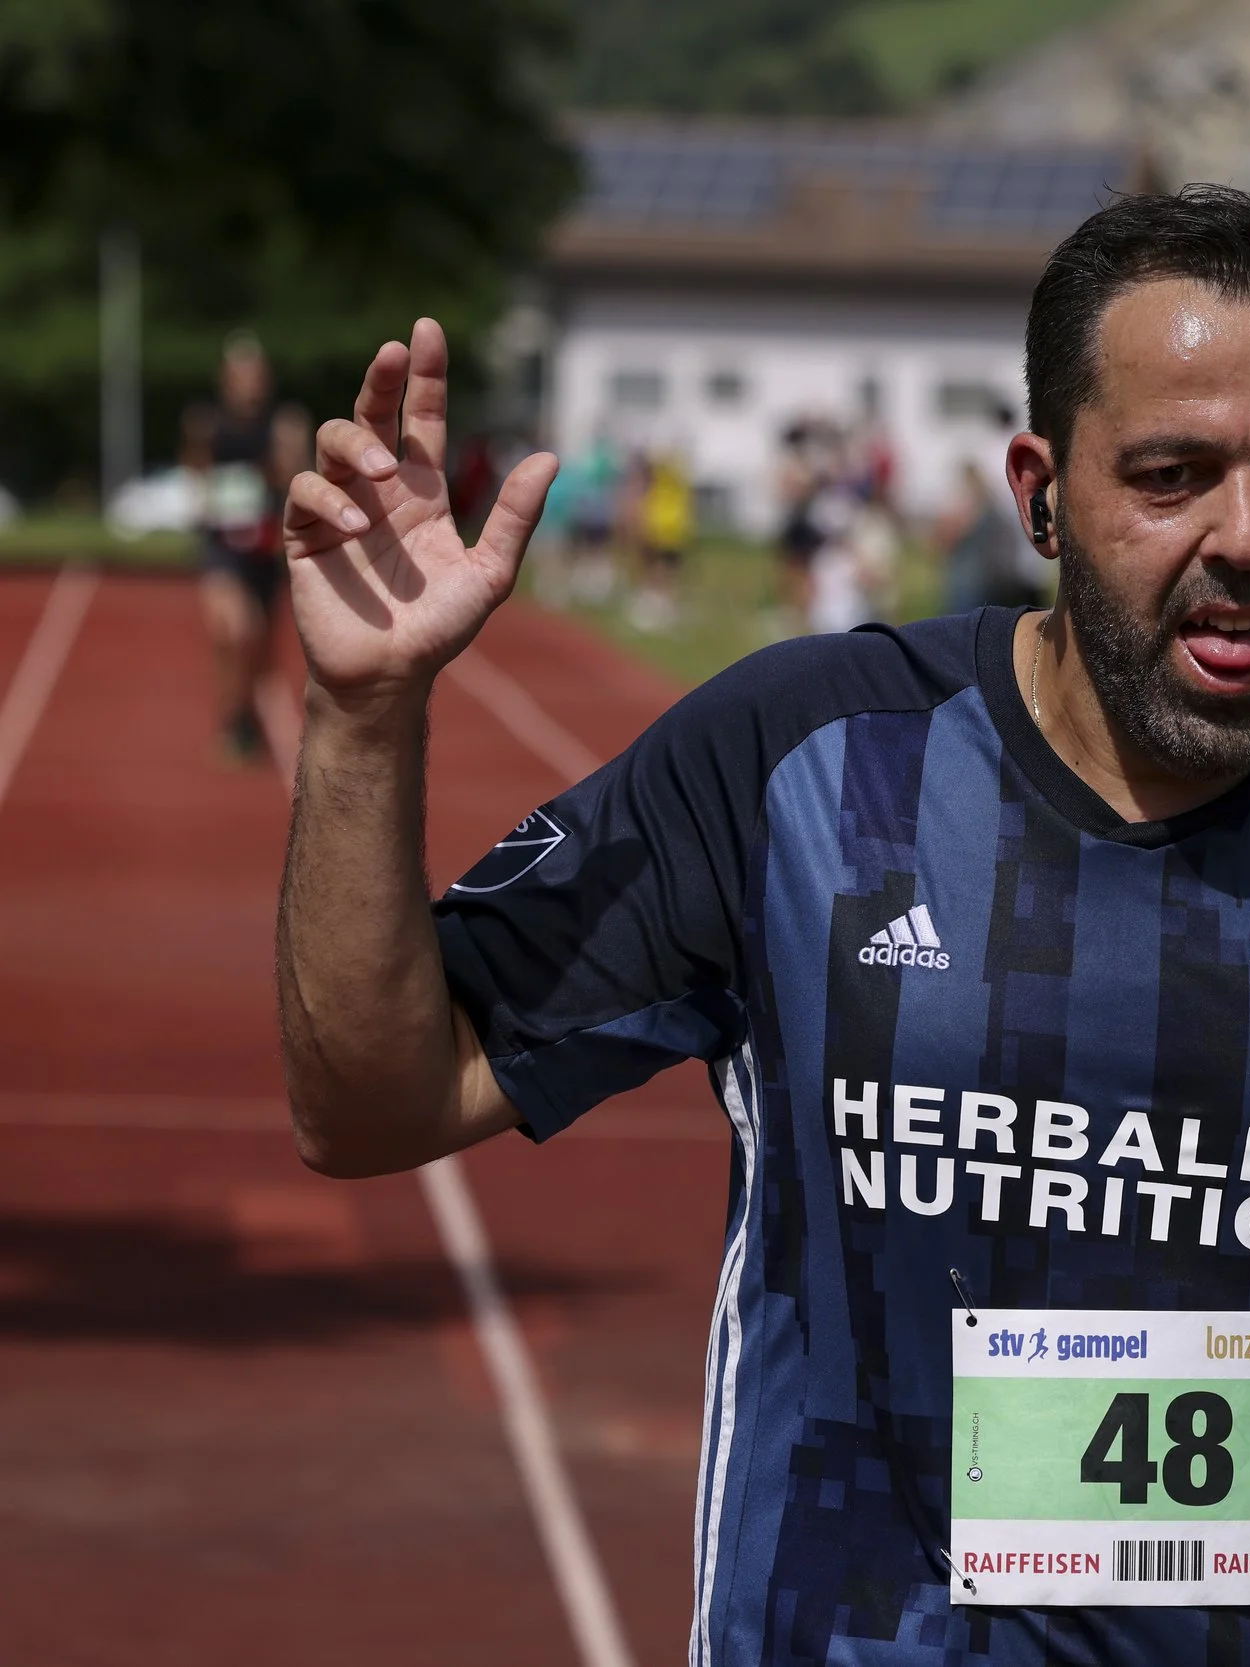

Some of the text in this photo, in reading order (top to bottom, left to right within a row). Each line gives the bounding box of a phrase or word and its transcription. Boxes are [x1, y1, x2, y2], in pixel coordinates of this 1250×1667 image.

[858, 943, 950, 970] adidas
[988, 1329, 1148, 1361] stv gampel
[972, 1412, 980, 1467] VS-TIMING.CH
[1080, 1391, 1234, 1507] 48
[963, 1552, 1100, 1574] RAIFFEISEN
